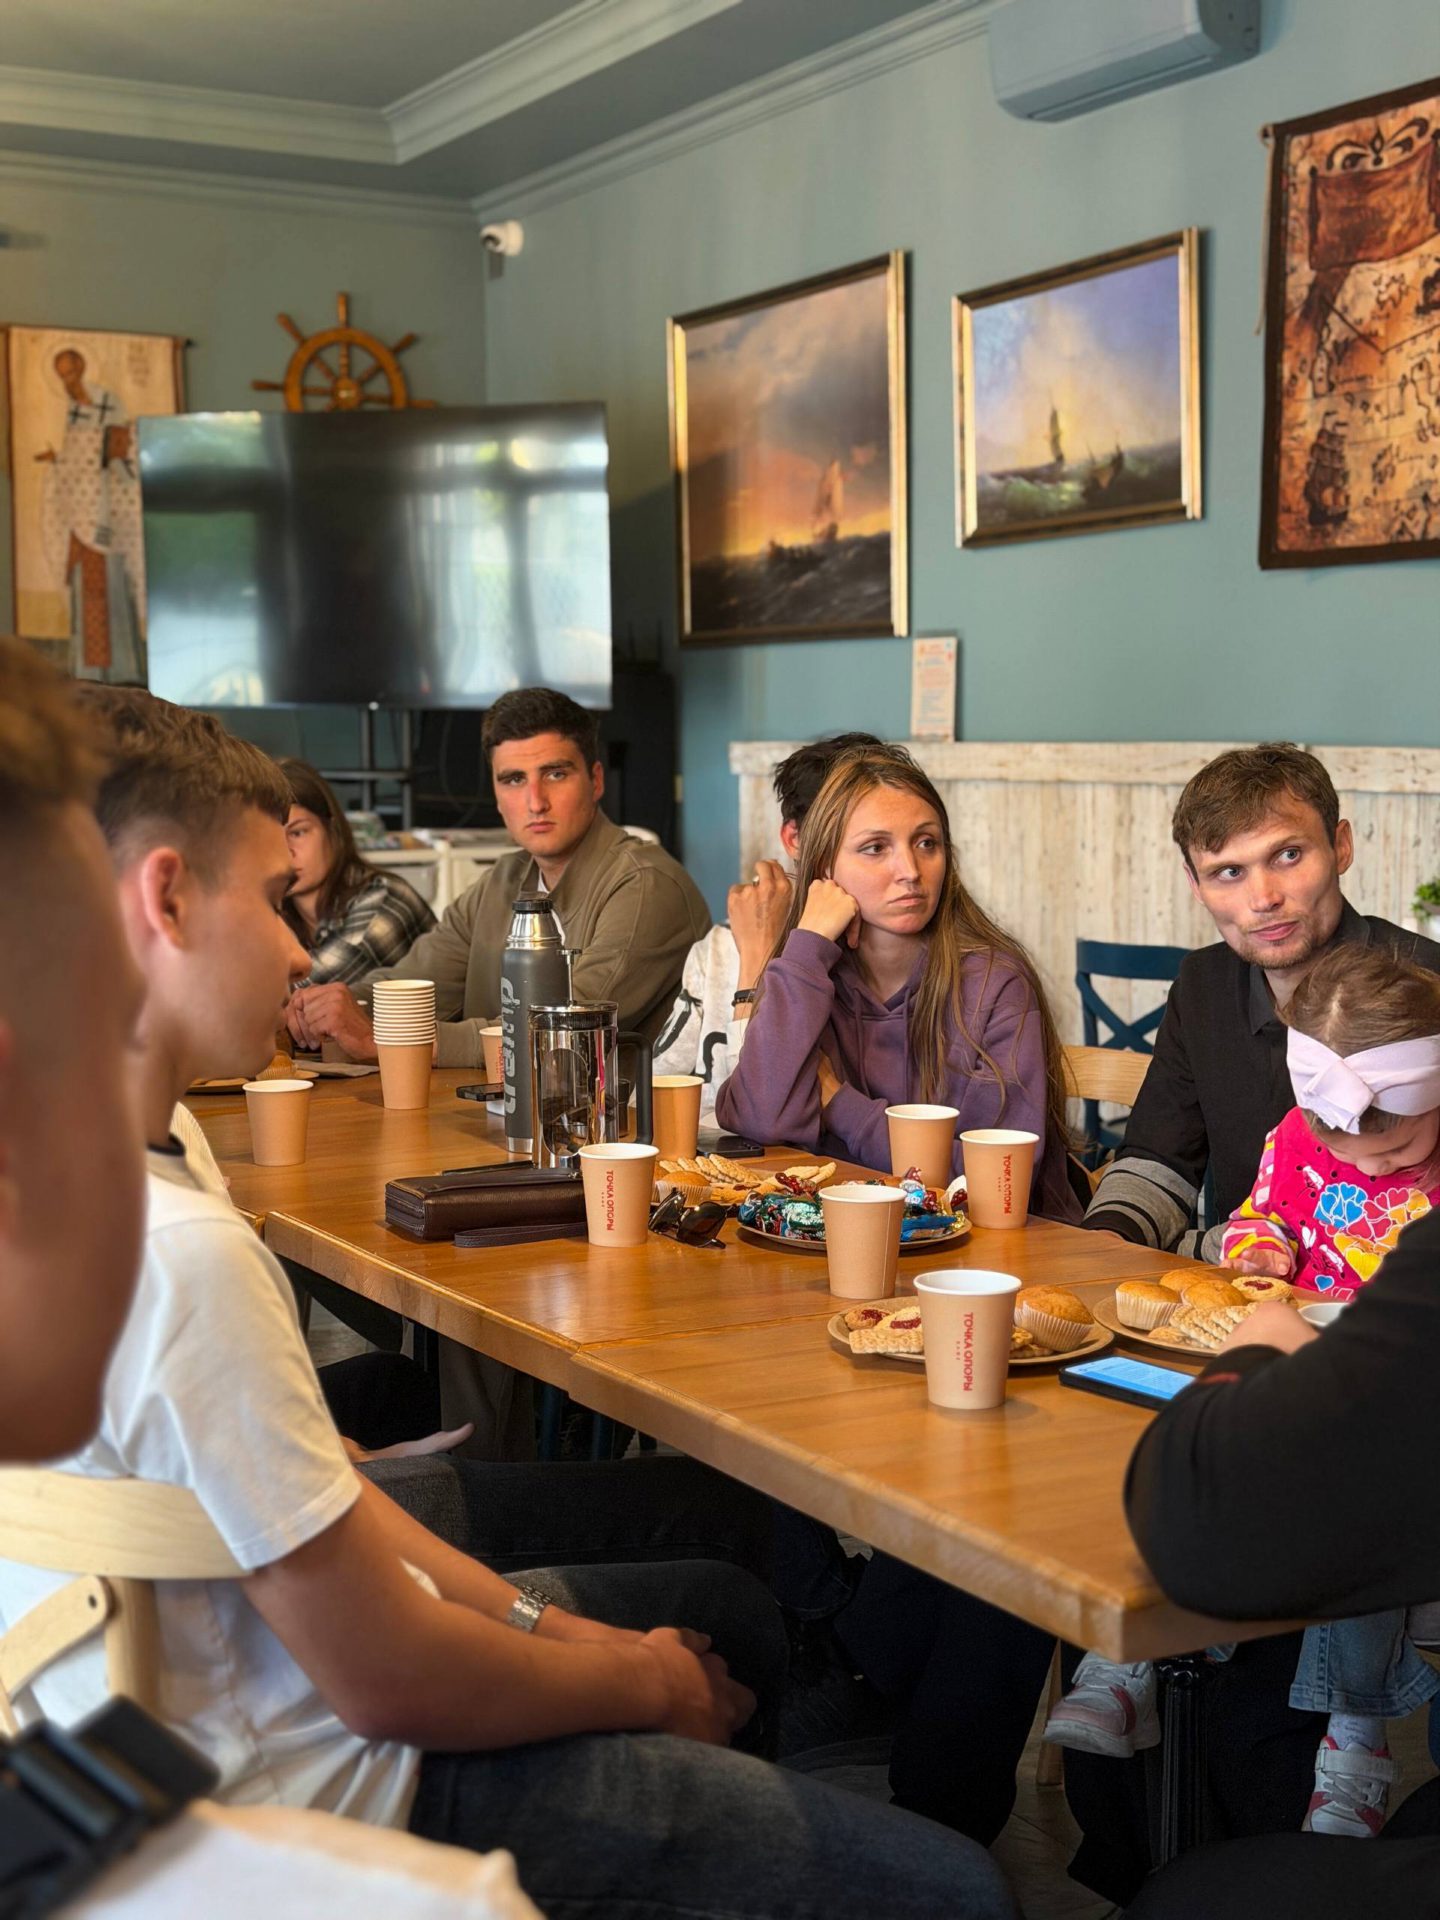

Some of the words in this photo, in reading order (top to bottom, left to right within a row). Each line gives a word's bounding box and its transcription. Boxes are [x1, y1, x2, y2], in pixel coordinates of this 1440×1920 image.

[1003, 1154, 1012, 1182] ТОЧКА
[606, 1170, 614, 1199] ТОЧКА
[1003, 1183, 1012, 1214] ОПОРЫ
[606, 1199, 614, 1231] ОПОРЫ
[963, 1312, 973, 1349] ТОЧКА
[963, 1350, 973, 1391] ОПОРЫ
